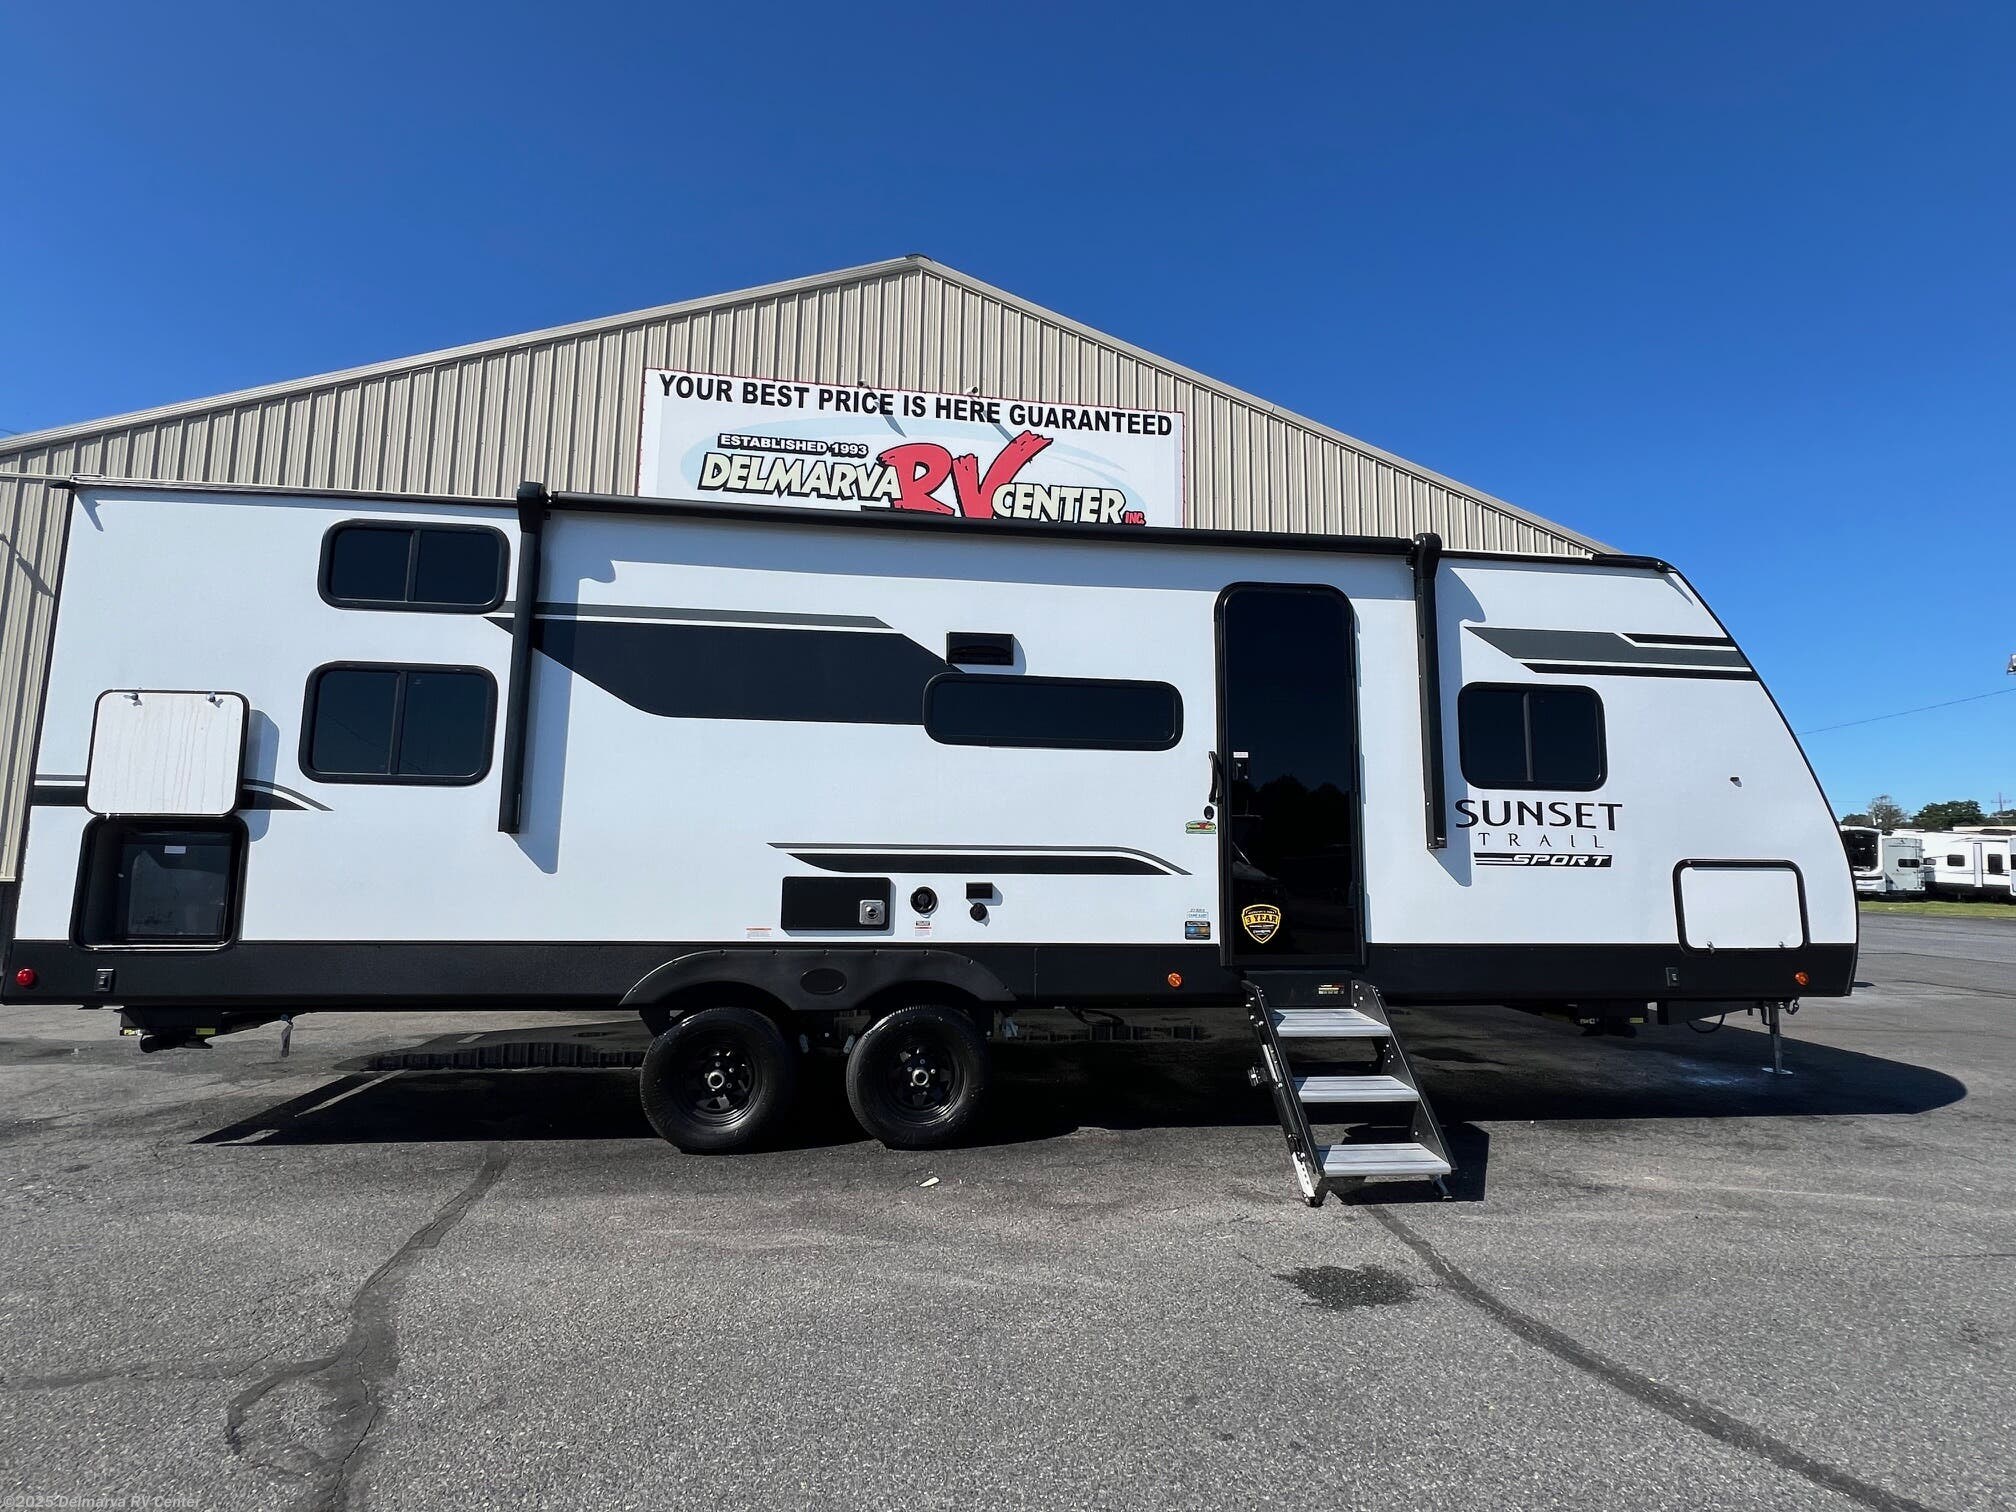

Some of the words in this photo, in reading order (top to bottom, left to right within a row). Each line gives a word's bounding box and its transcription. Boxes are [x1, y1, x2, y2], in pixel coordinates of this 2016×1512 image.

[659, 373, 733, 403] YOUR
[742, 382, 809, 409] BEST
[818, 388, 894, 416] PRICE
[903, 394, 926, 417] IS
[935, 397, 1000, 424] HERE
[1009, 404, 1172, 436] GUARANTEED
[719, 433, 828, 454] ESTABLISHED
[831, 442, 868, 457] 1993
[698, 452, 902, 501] DELMARVA
[877, 430, 1053, 520] RV
[992, 482, 1126, 524] CENTER
[1454, 799, 1623, 831] SUNSET
[1478, 833, 1605, 848] TRAIL
[1512, 854, 1610, 866] SPORT
[1253, 914, 1277, 923] YEAR
